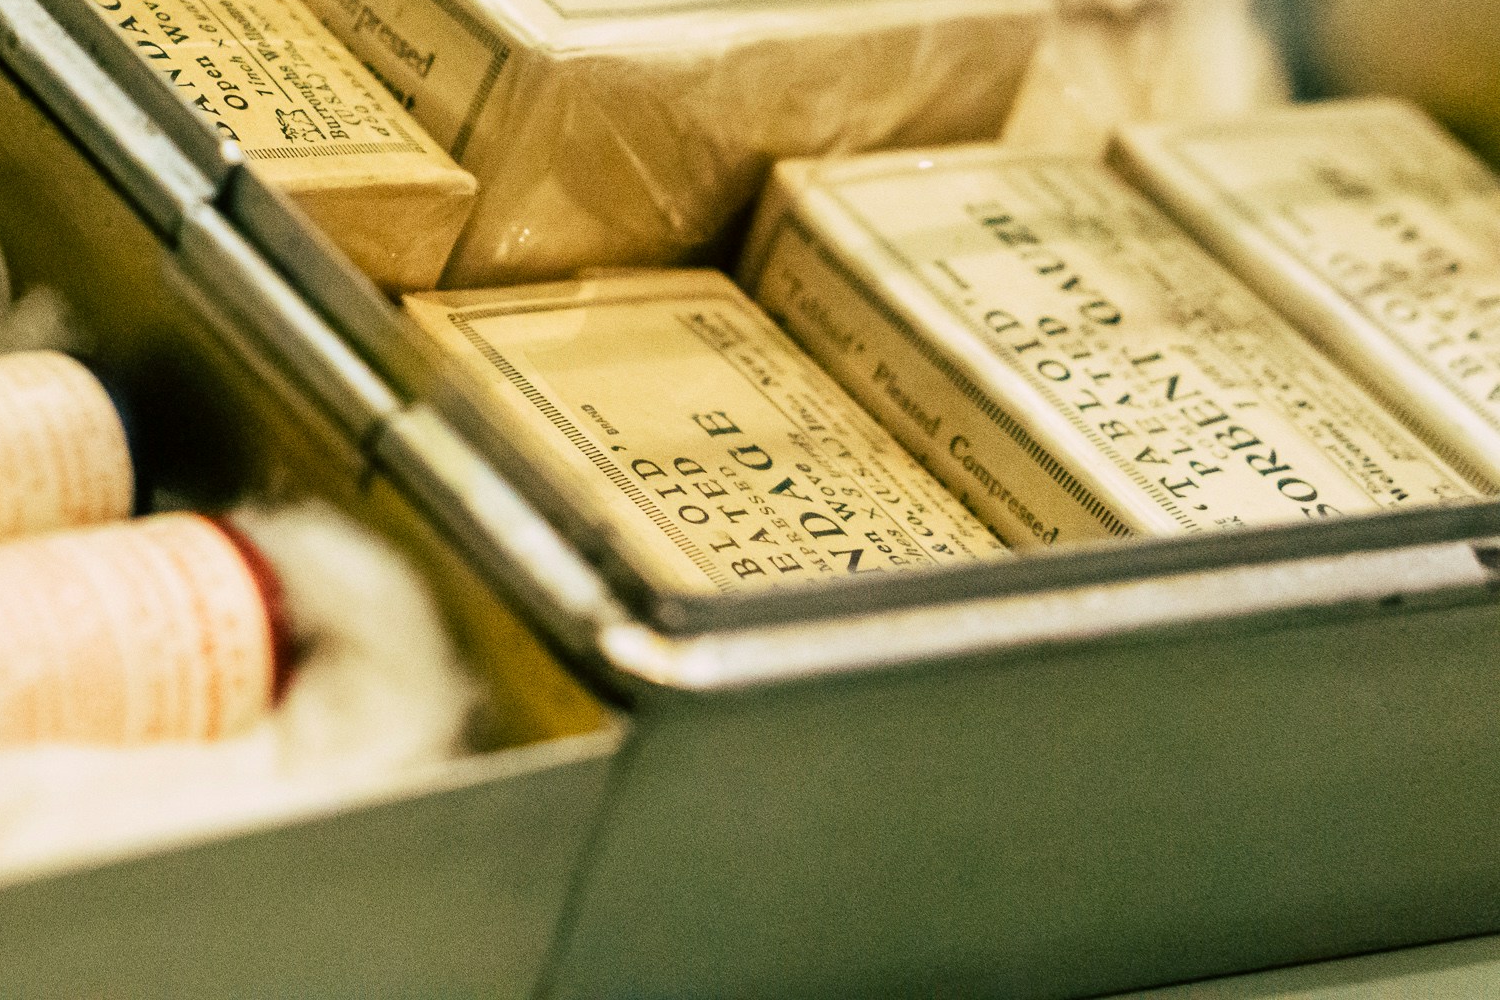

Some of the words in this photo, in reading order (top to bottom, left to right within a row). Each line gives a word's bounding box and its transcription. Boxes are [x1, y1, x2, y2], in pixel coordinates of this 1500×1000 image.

[195, 55, 250, 112] Open
[278, 63, 352, 141] Burroughs
[580, 403, 621, 437] BRAND
[1035, 316, 1225, 478] PLEATED
[794, 462, 858, 522] Wove
[948, 433, 1059, 547] Compressed
